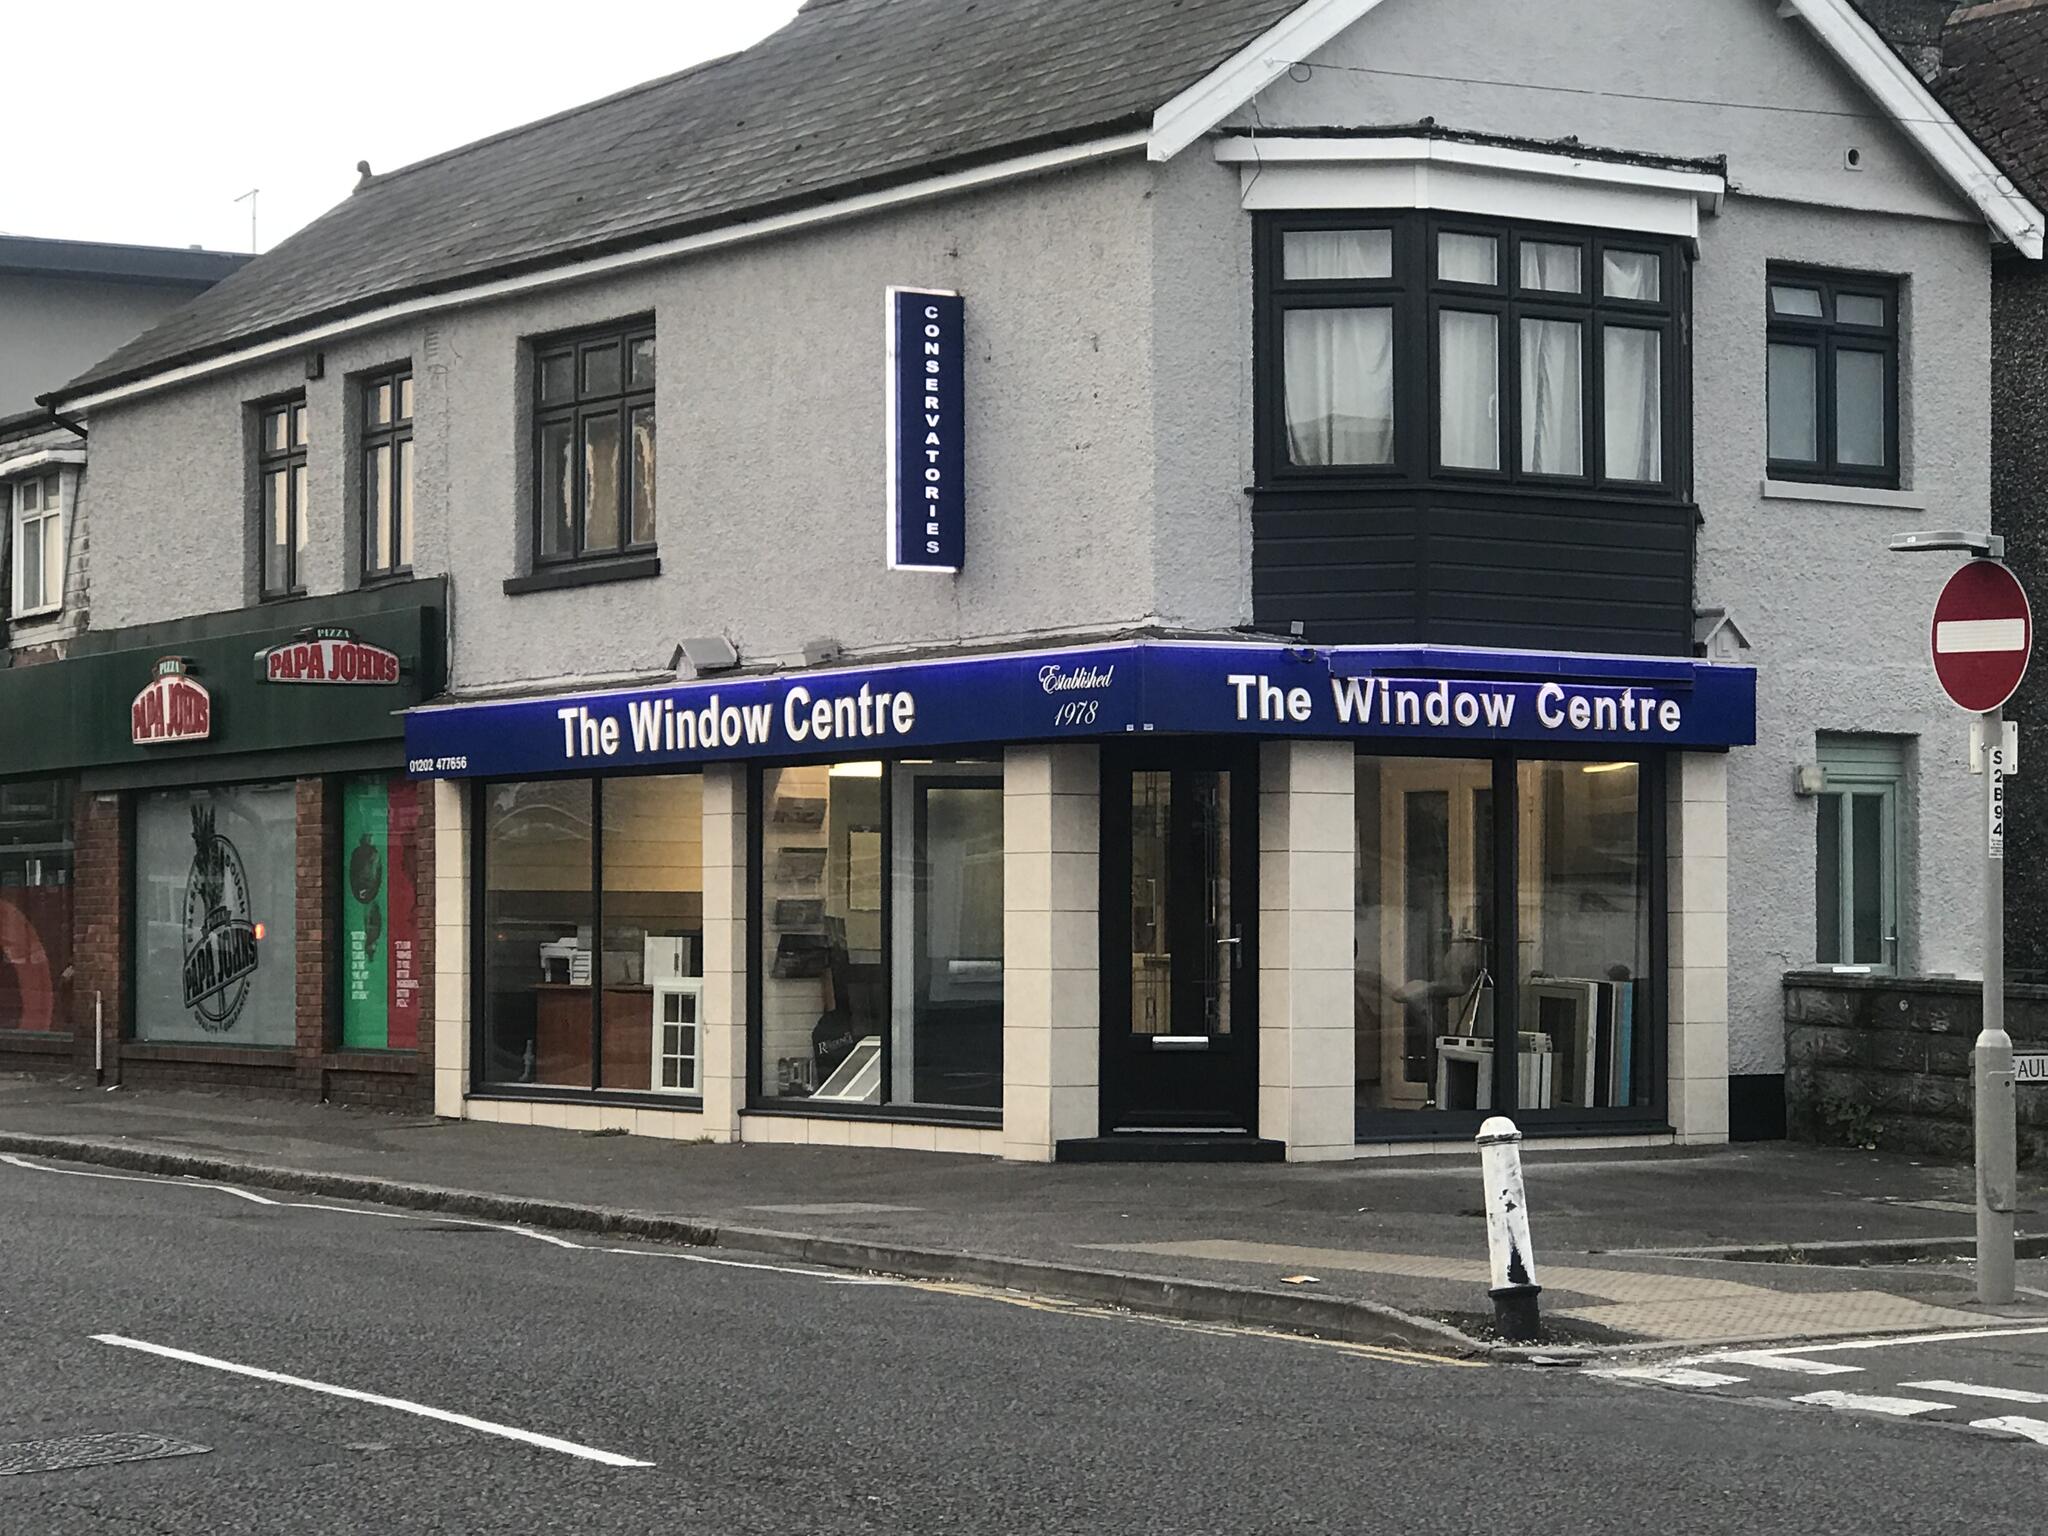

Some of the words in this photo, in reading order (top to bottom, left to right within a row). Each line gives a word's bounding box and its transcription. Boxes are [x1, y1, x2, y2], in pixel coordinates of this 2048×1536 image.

[924, 305, 941, 554] CONSERVATORIES
[270, 644, 325, 679] PAPA
[1038, 664, 1114, 694] Established
[133, 686, 164, 739] PAPA
[557, 706, 620, 758] The
[628, 694, 773, 753] Window
[784, 681, 915, 742] Centre
[1054, 700, 1099, 726] 1978
[1227, 674, 1312, 722] The
[1331, 676, 1515, 728] Window
[1536, 682, 1681, 732] Centre
[409, 758, 434, 773] 01202
[436, 756, 467, 770] 477656
[185, 940, 216, 1002] PAPA
[2012, 1059, 2048, 1078] AUL
